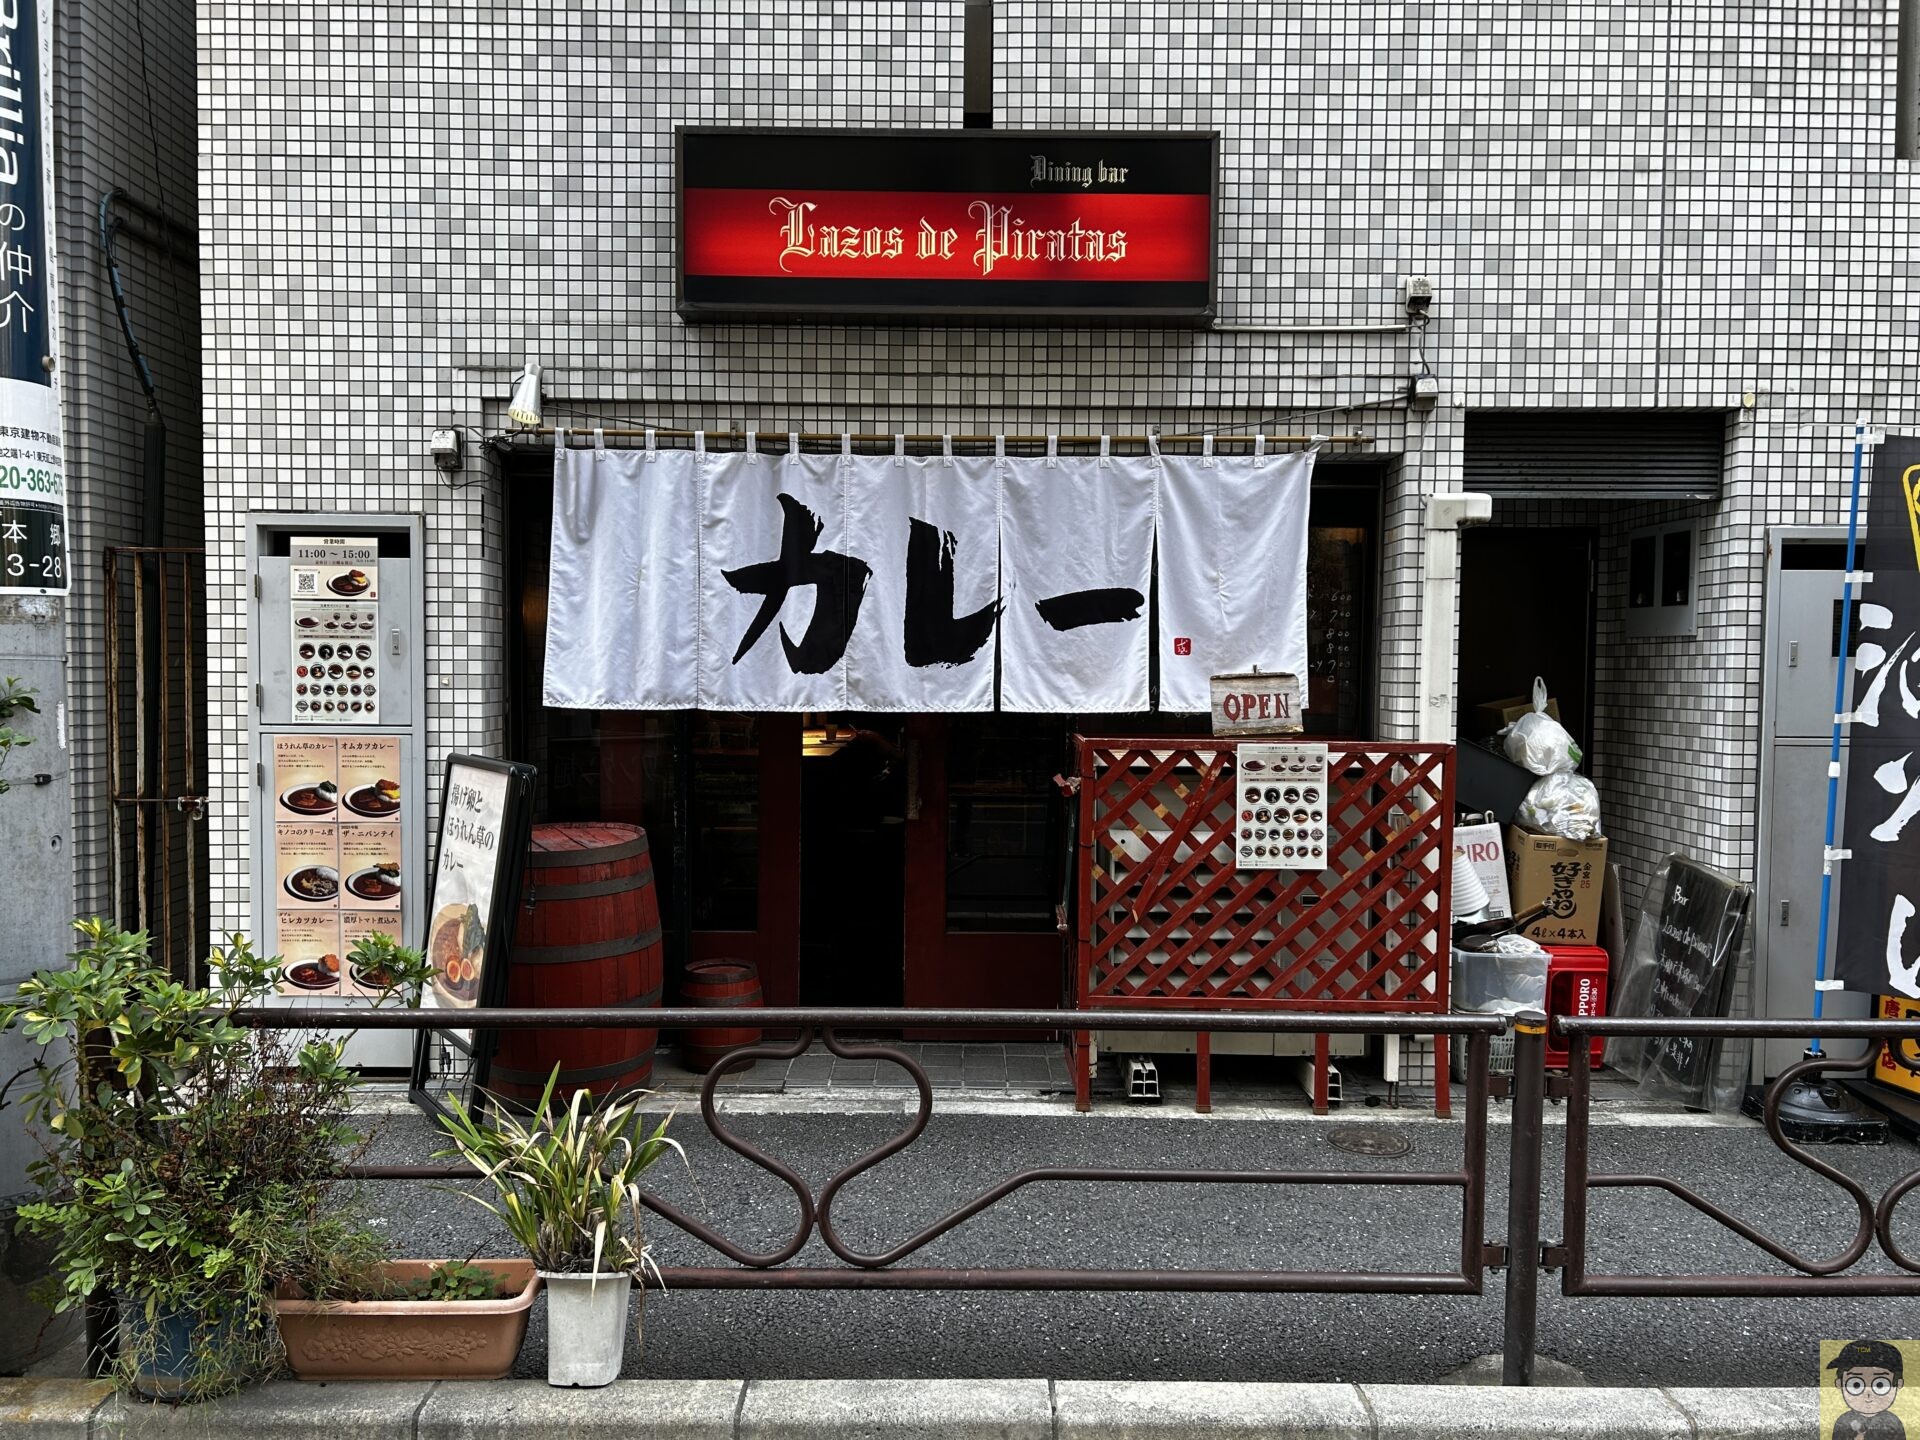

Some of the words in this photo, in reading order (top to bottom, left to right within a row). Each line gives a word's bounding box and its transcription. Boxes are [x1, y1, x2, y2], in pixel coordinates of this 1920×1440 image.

[1030, 154, 1093, 188] Dining
[1097, 159, 1129, 183] bar
[768, 196, 905, 273] Lazos
[915, 216, 957, 261] de
[968, 199, 1128, 277] Piratas
[7, 553, 62, 578] 3-28
[298, 549, 326, 558] 11:00
[342, 549, 371, 559] 15:00
[721, 492, 1146, 675] カレー
[1223, 692, 1291, 724] OPEN
[276, 742, 335, 750] ほうれん草のカレー
[340, 742, 394, 751] オムカツカレー
[446, 816, 495, 851] ほうれん草の
[442, 848, 464, 872] カレー
[281, 916, 334, 924] ヒレカツカレー
